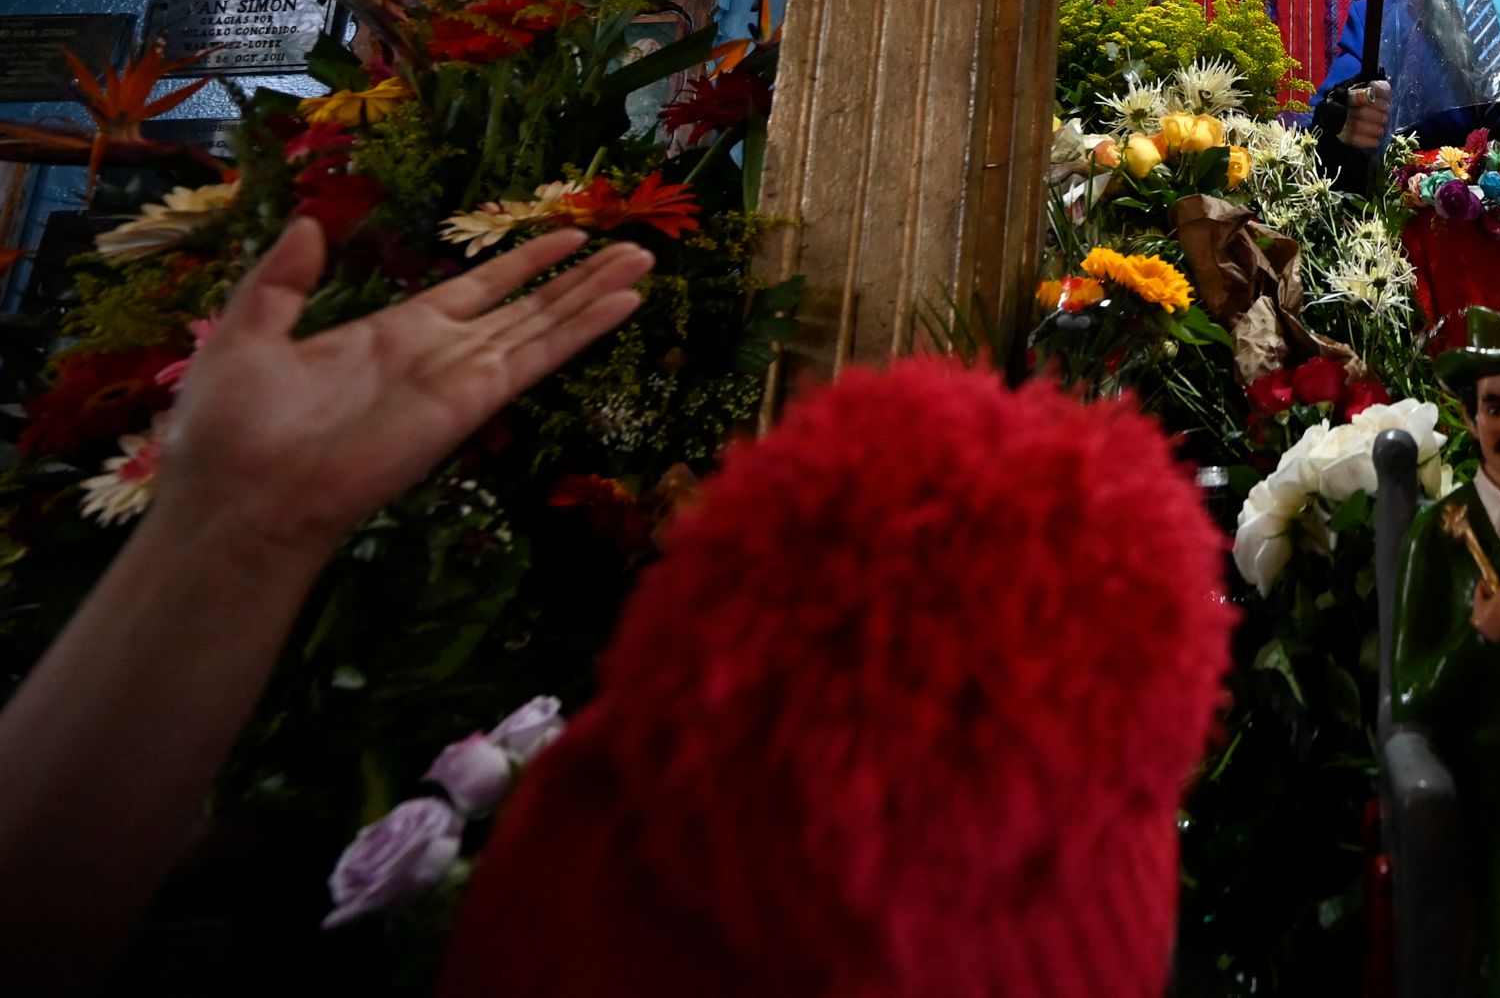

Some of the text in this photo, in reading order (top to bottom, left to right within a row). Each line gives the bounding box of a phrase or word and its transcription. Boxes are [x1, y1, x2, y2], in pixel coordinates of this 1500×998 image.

[200, 15, 273, 25] GRACIAS POR
[235, 26, 300, 36] CONCEDIDO.
